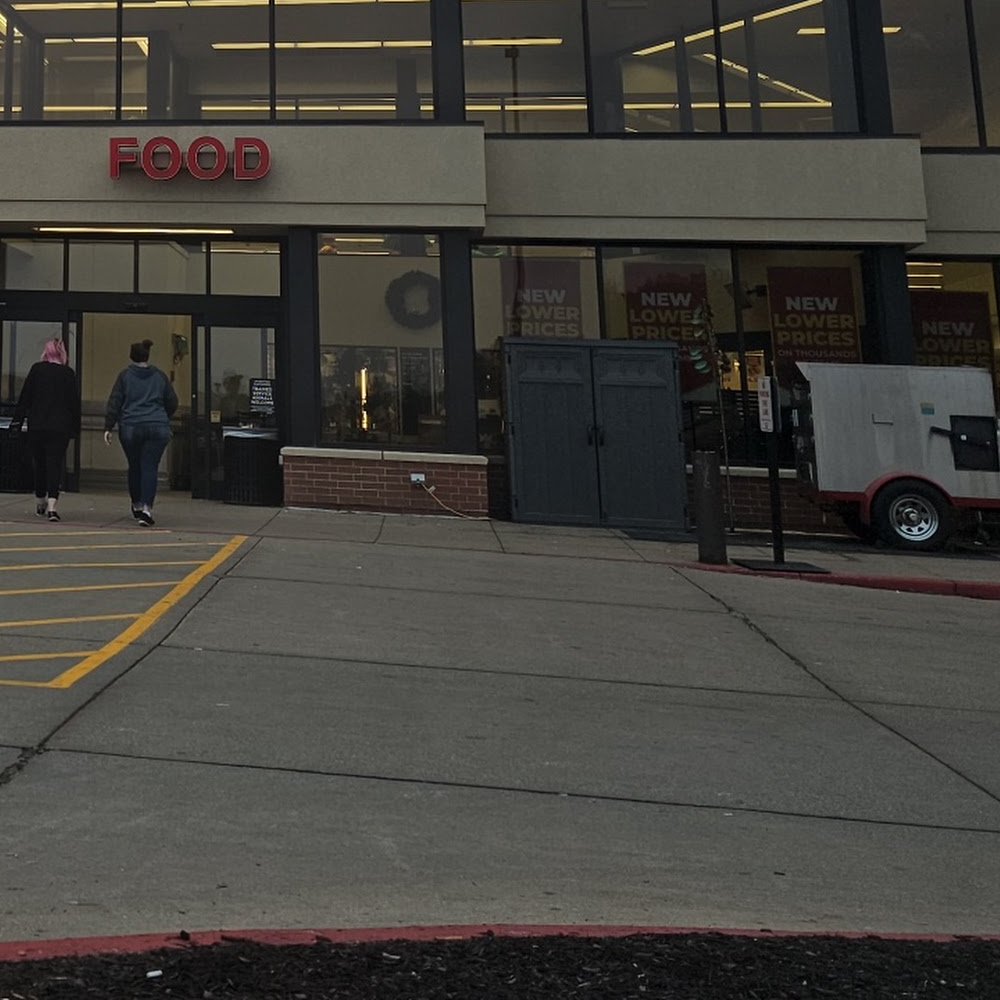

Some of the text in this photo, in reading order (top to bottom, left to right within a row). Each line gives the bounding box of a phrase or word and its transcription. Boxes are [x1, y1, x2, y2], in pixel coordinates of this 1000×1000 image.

[109, 136, 271, 180] FOOD
[517, 289, 566, 304] NEW
[640, 291, 692, 307] NEW
[786, 296, 838, 311] NEW
[504, 304, 580, 320] LOWER
[630, 308, 705, 324] LOWE
[774, 313, 854, 329] LOWER
[921, 320, 975, 336] NEW
[506, 321, 579, 338] PRICES
[777, 331, 855, 347] PRICES
[778, 349, 858, 359] ON THOUSANDS
